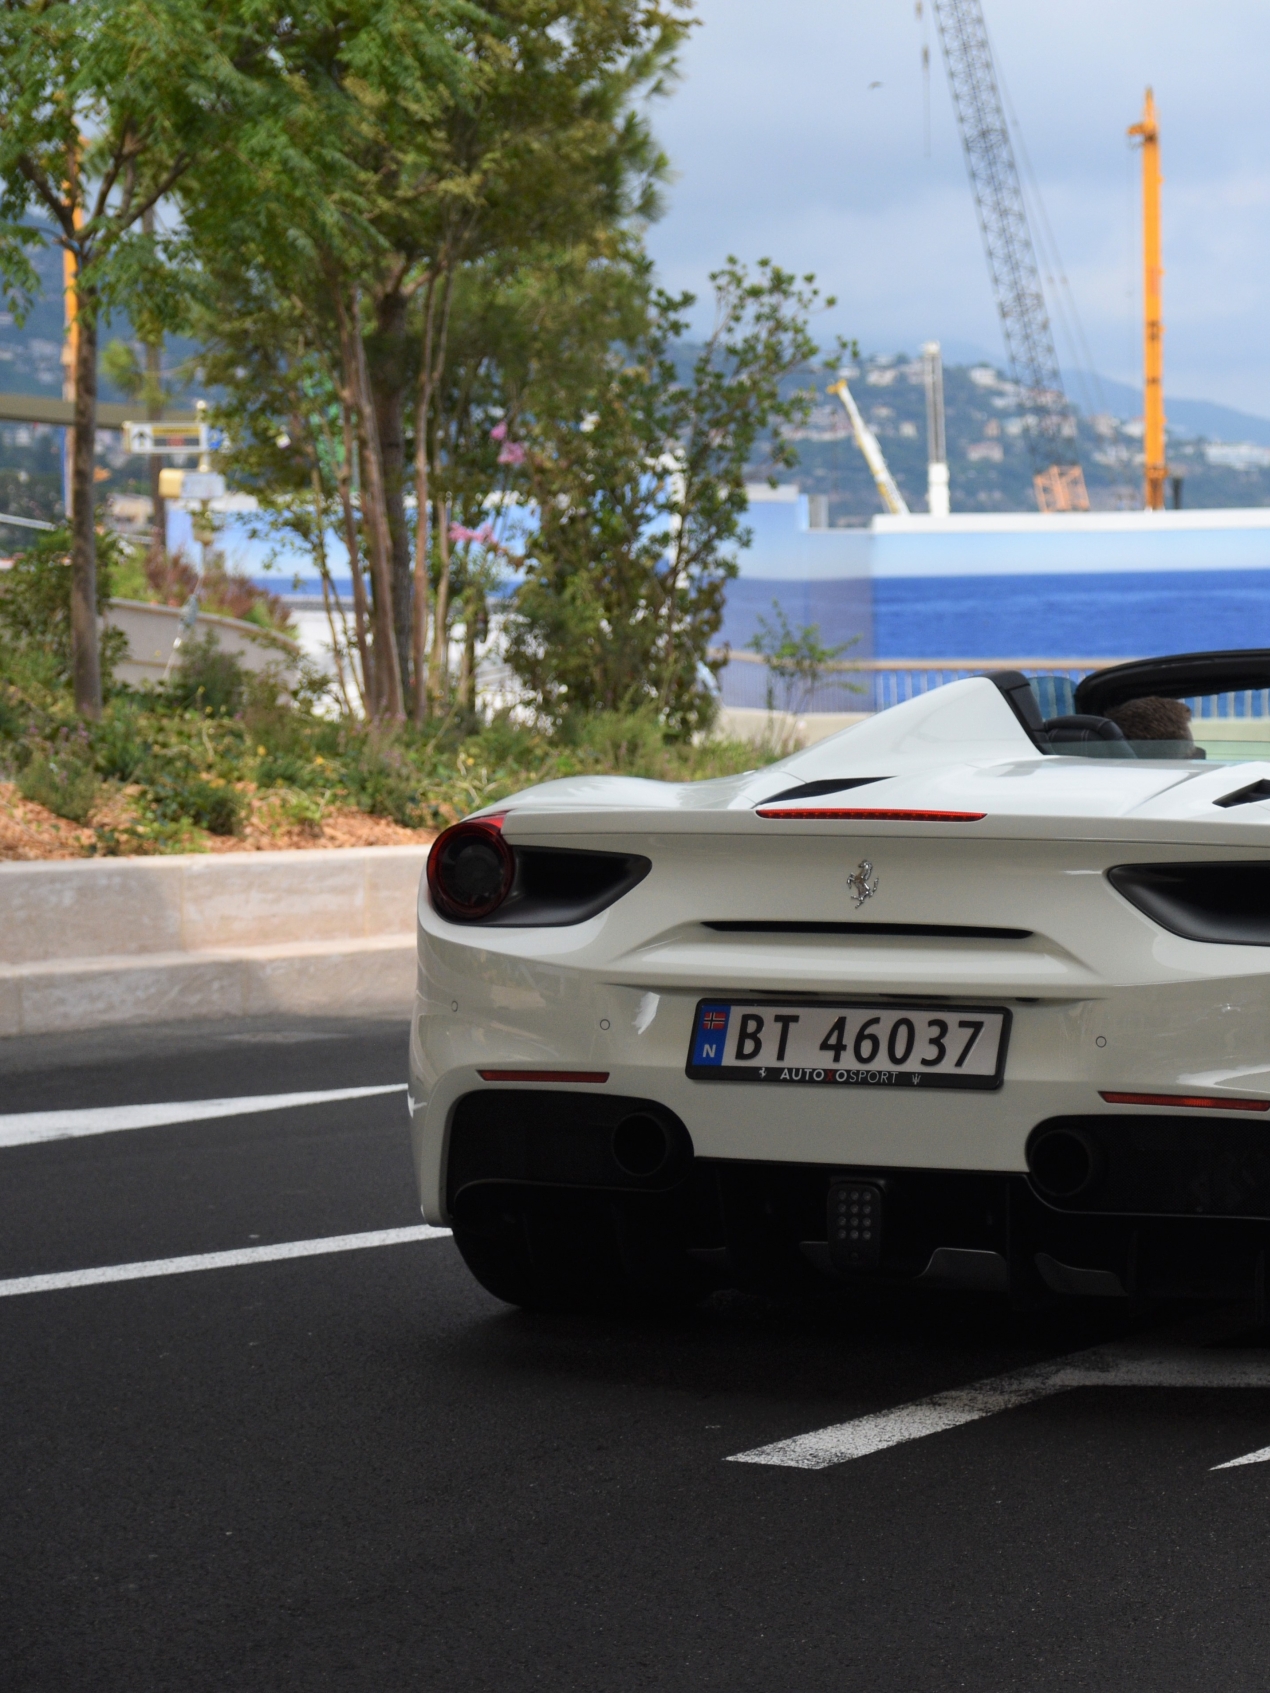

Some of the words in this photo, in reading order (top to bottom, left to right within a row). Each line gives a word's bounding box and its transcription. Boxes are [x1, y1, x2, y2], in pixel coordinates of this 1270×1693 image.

[702, 1044, 716, 1058] N
[735, 1013, 799, 1062] BT
[819, 1016, 984, 1068] 46037
